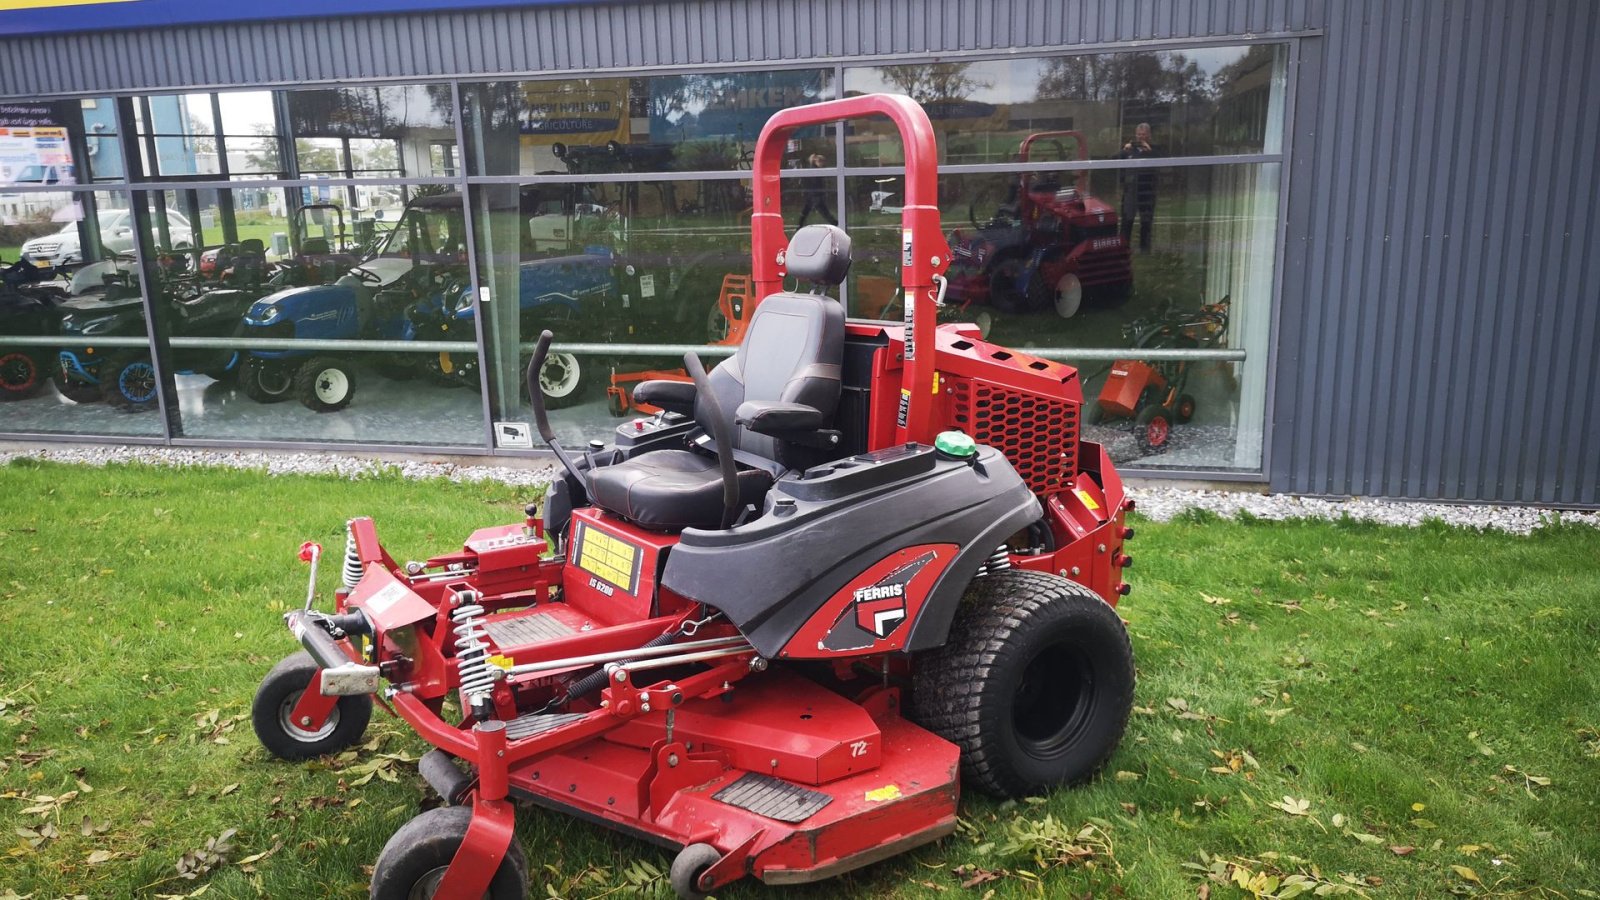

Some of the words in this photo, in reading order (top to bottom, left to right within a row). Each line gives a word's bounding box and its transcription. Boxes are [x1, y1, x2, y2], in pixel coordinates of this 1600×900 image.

[533, 120, 593, 131] GRICULTURE
[588, 577, 598, 588] IS
[596, 581, 614, 597] 6200
[856, 584, 904, 602] FERRIS
[851, 741, 867, 757] 72
